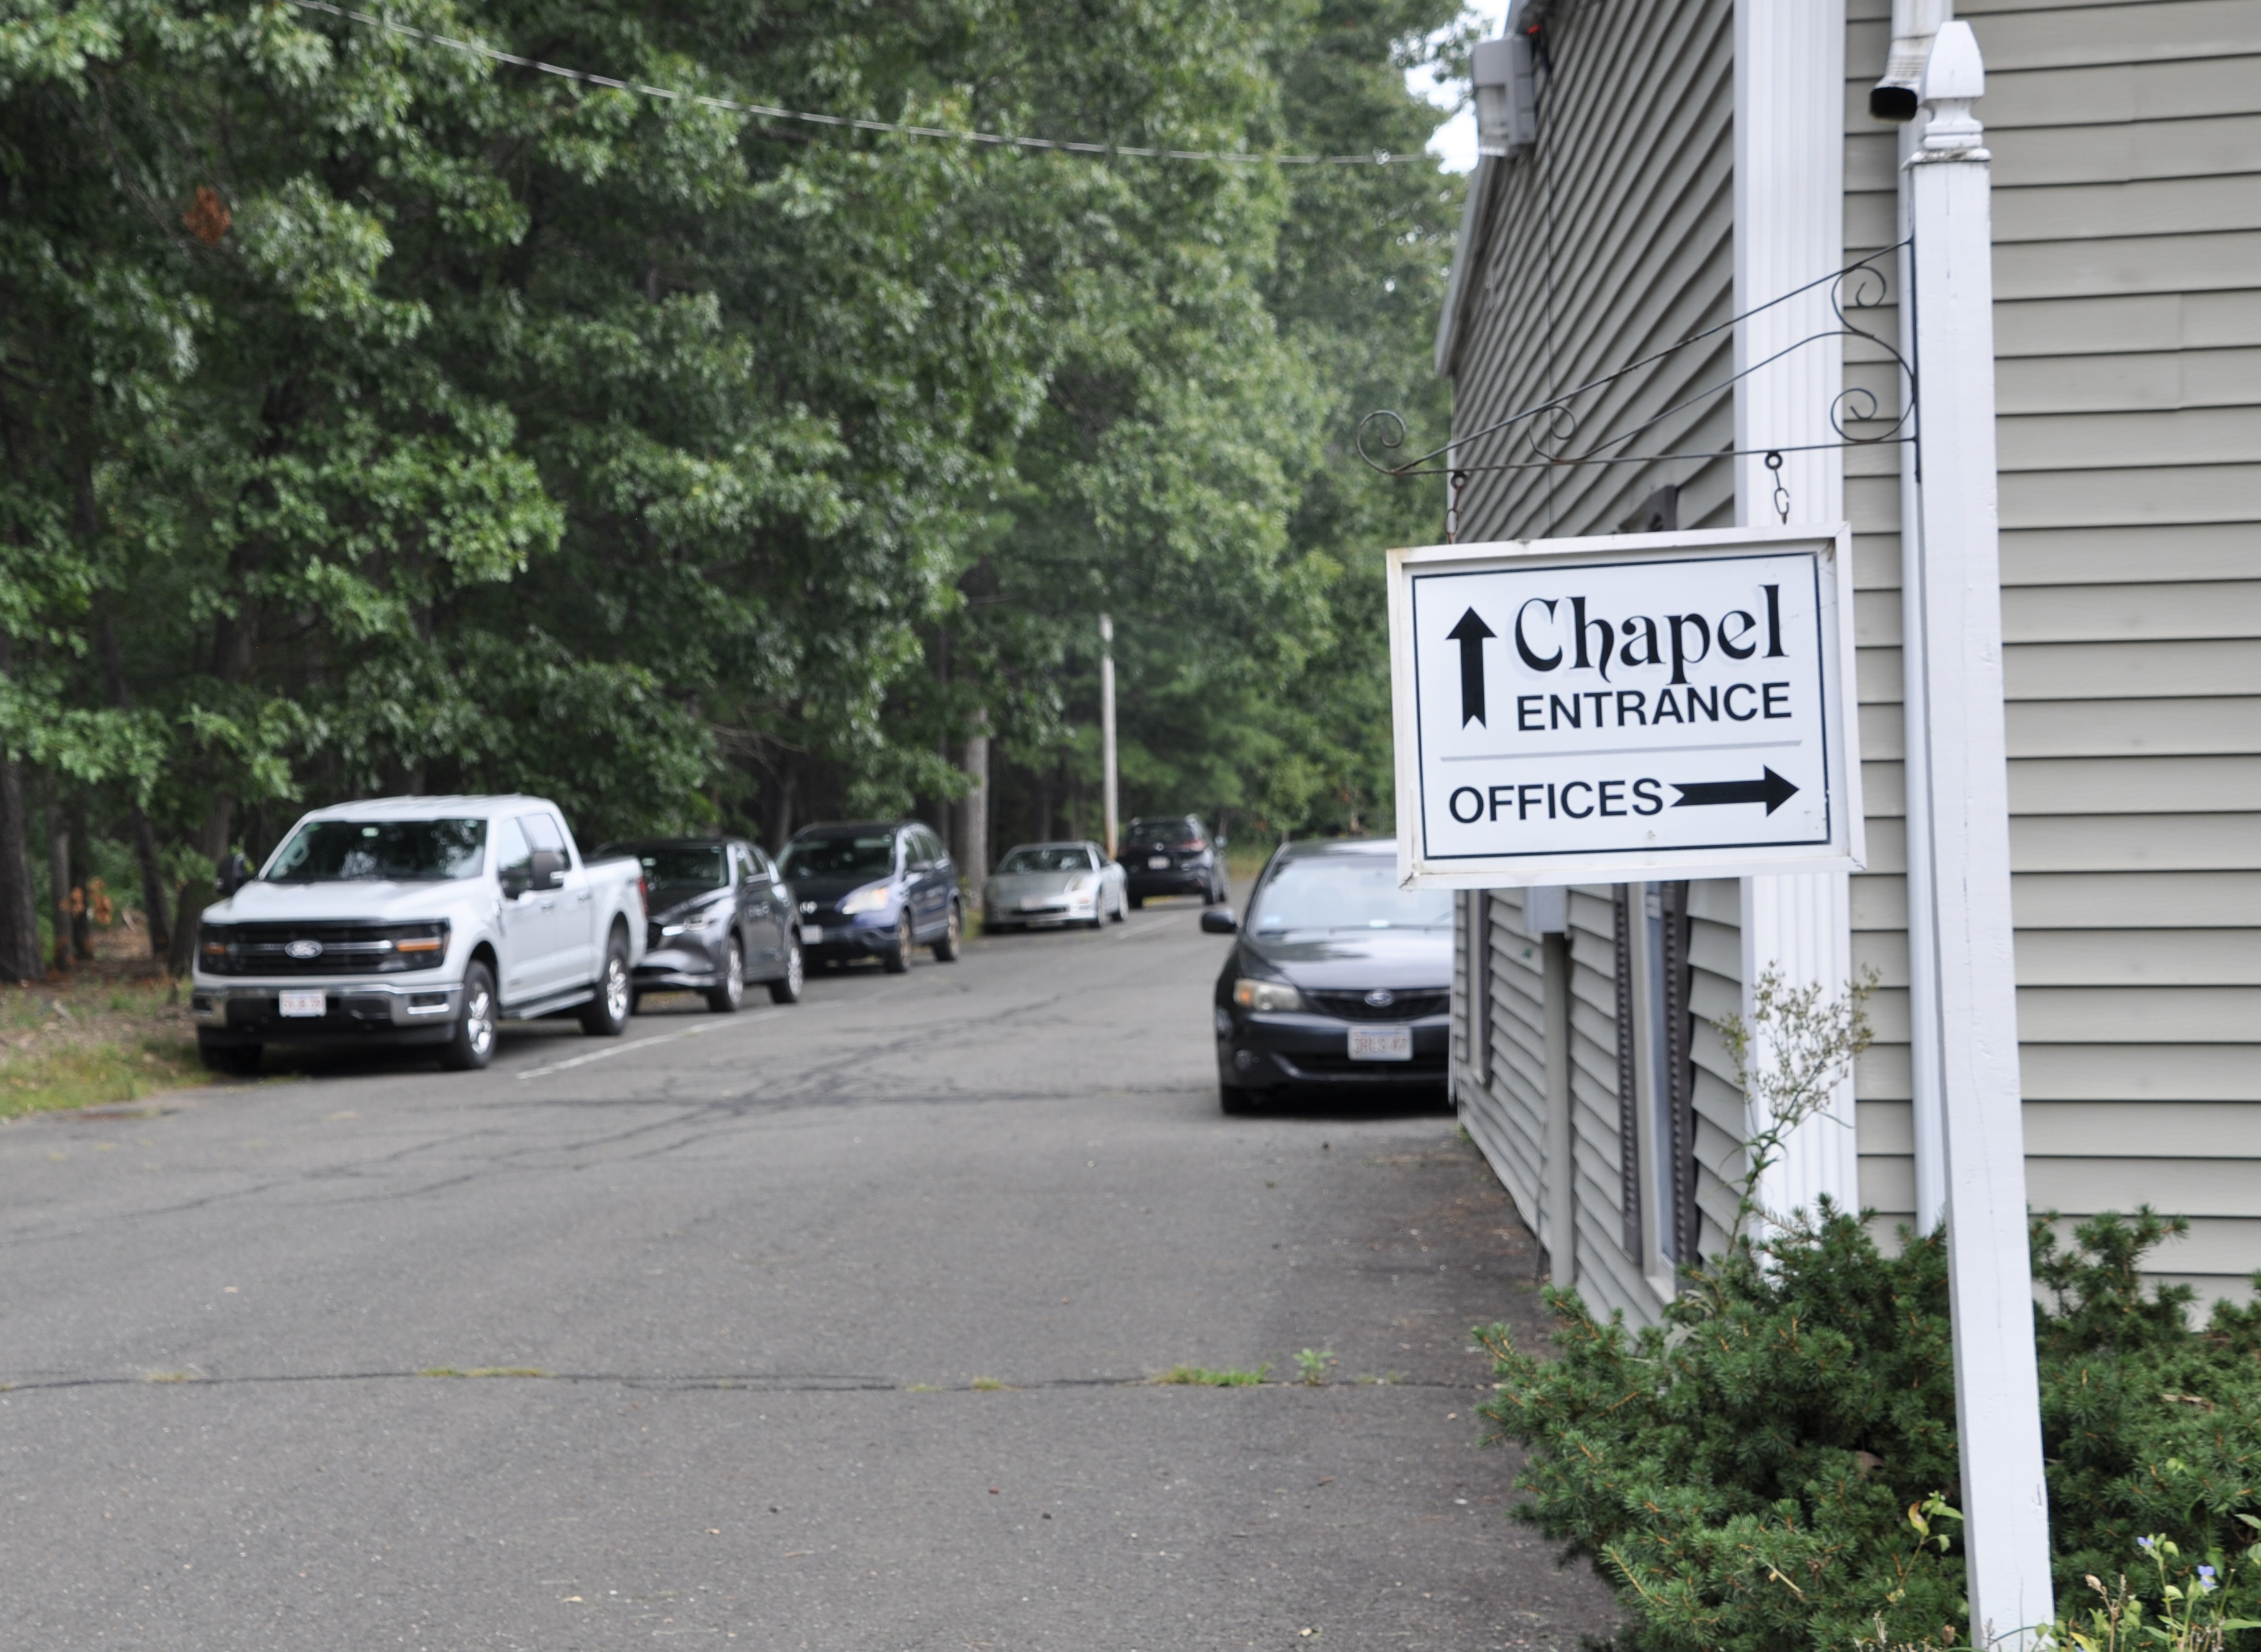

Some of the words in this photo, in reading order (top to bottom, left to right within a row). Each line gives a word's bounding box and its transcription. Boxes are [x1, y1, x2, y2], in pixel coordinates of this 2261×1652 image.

[1514, 584, 1790, 685] Chapel
[1517, 681, 1792, 731] ENTRANCE
[1449, 777, 1664, 824] OFFICES
